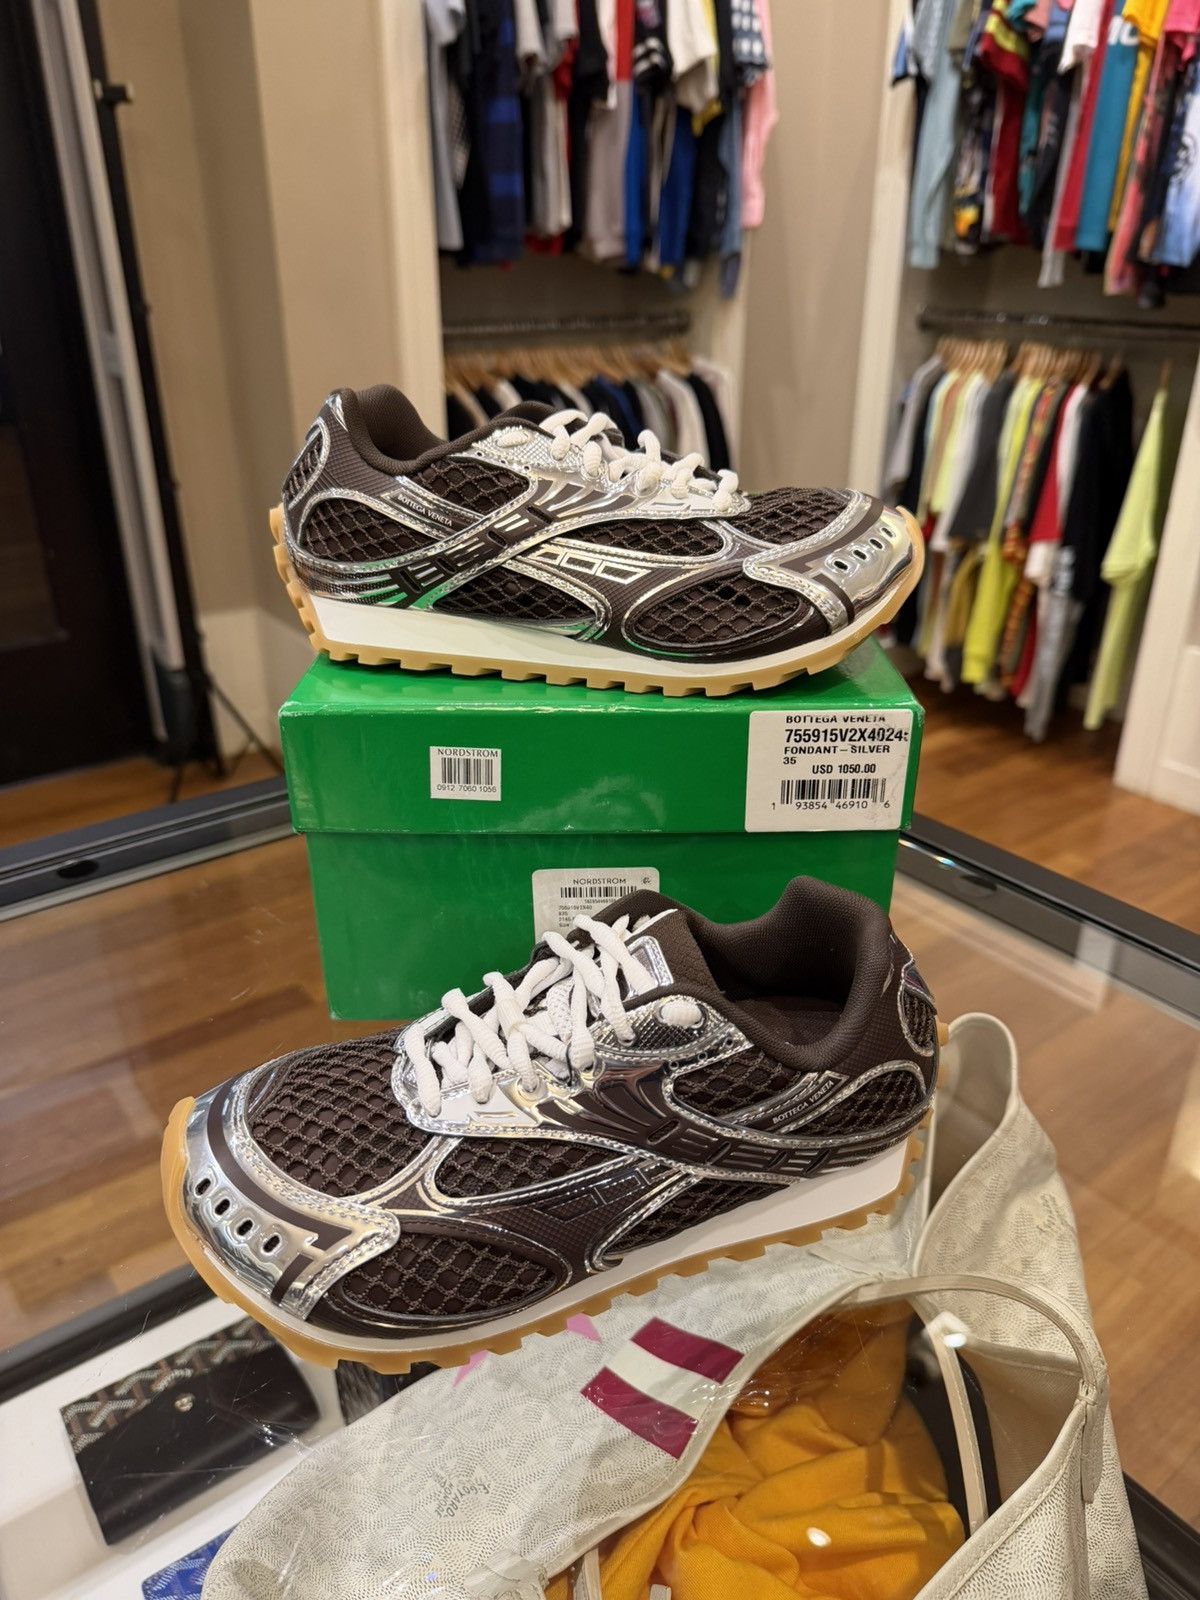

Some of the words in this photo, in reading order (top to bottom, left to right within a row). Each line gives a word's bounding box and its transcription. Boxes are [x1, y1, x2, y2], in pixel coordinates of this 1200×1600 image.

[397, 493, 426, 515] BOTTEGA
[427, 509, 453, 527] VENETA
[785, 715, 838, 724] BOTTEGA
[842, 714, 886, 724] VENETA
[437, 748, 499, 758] NORDSTROM
[782, 756, 797, 765] 35
[811, 764, 834, 775] USD
[837, 763, 877, 774] 1050.00
[795, 801, 828, 811] 93854
[835, 800, 868, 810] 46910
[883, 799, 890, 809] 6
[572, 877, 627, 885] NORDSTROM
[772, 1101, 809, 1125] BOTTEGA
[808, 1079, 834, 1103] VENETA
